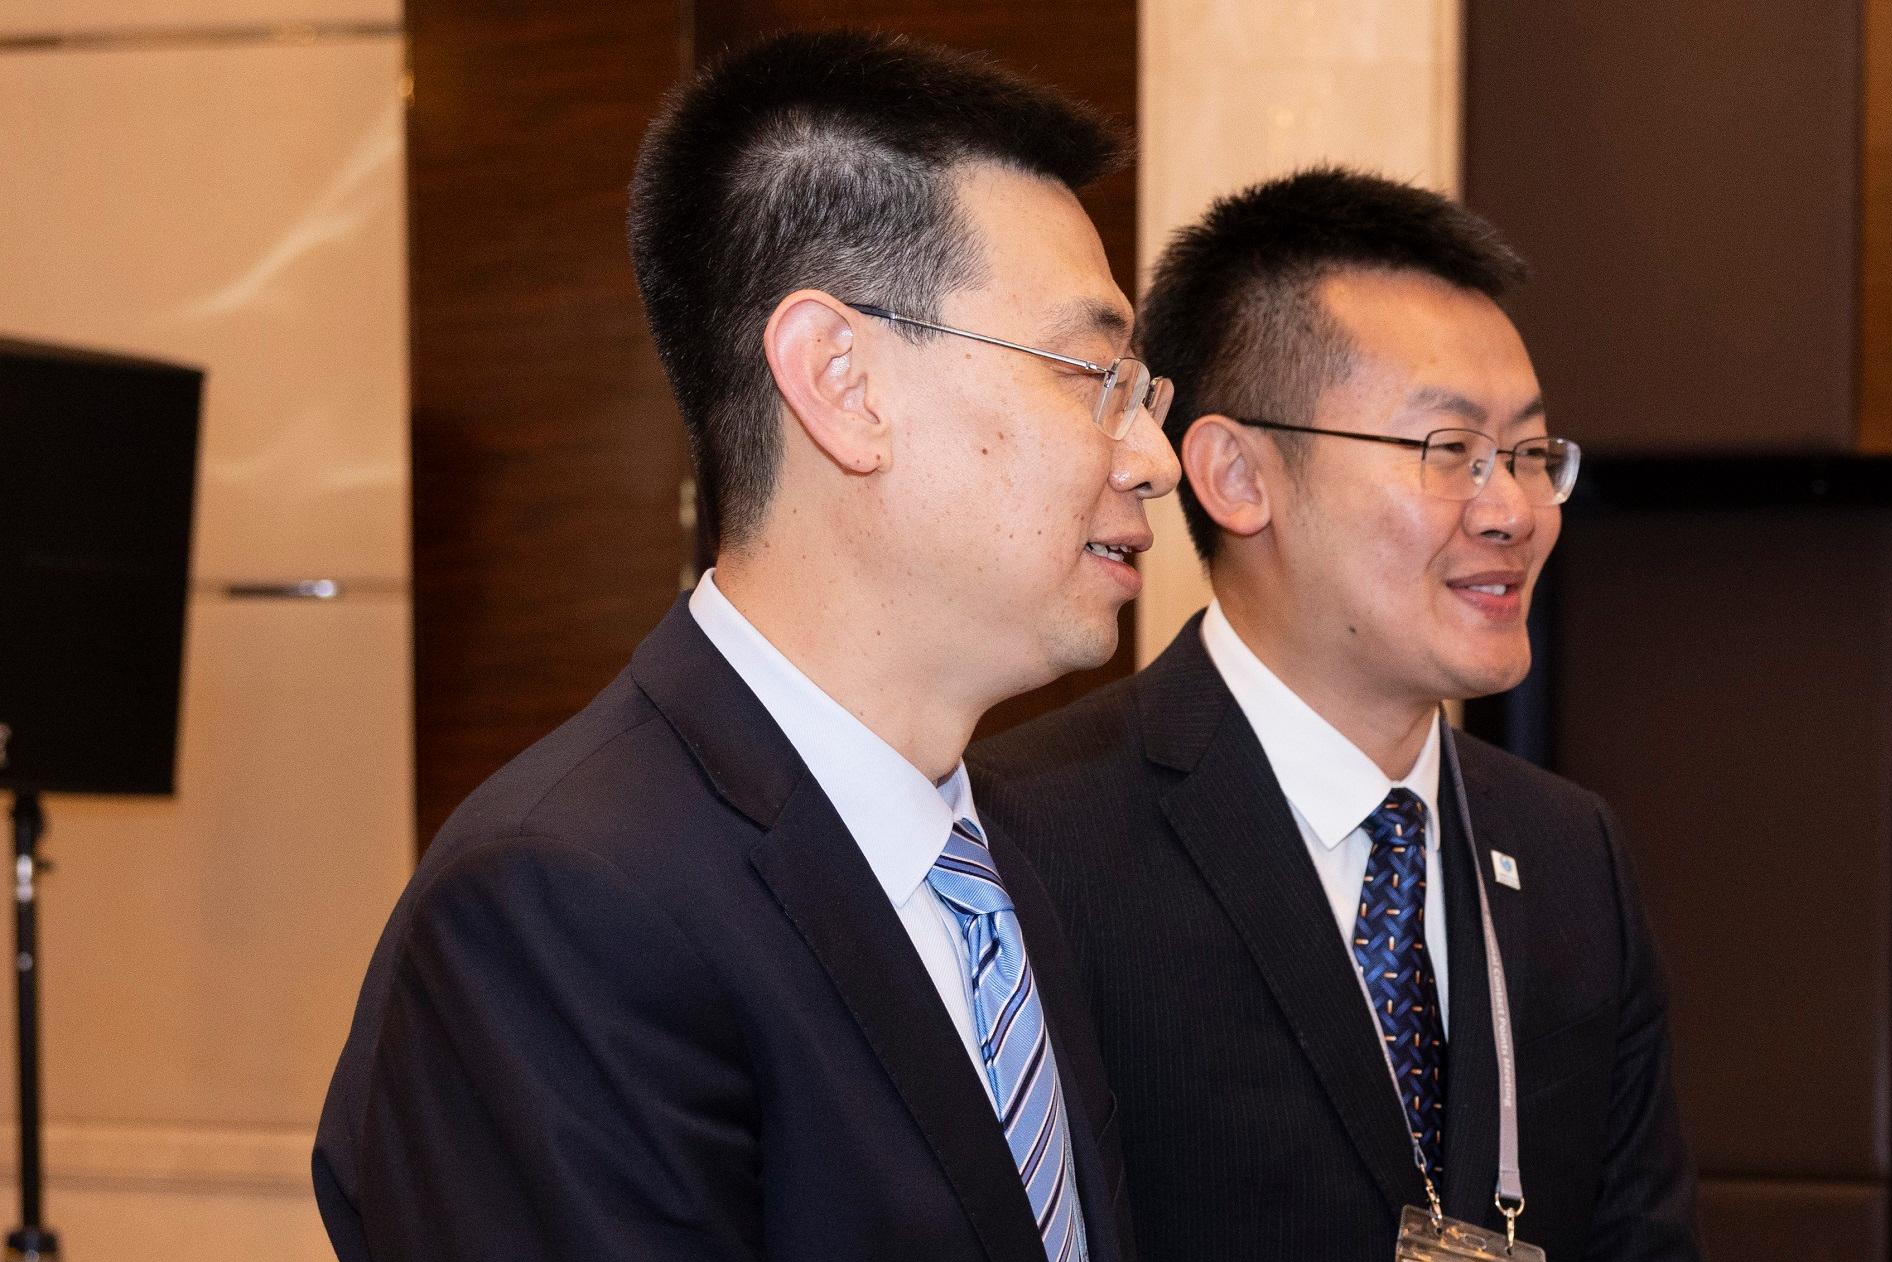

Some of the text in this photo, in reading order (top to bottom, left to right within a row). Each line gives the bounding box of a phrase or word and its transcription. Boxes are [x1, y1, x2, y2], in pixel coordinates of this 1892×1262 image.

[1493, 968, 1505, 1014] Contact
[1498, 1017, 1509, 1055] Points
[1502, 1058, 1513, 1107] Meeting
